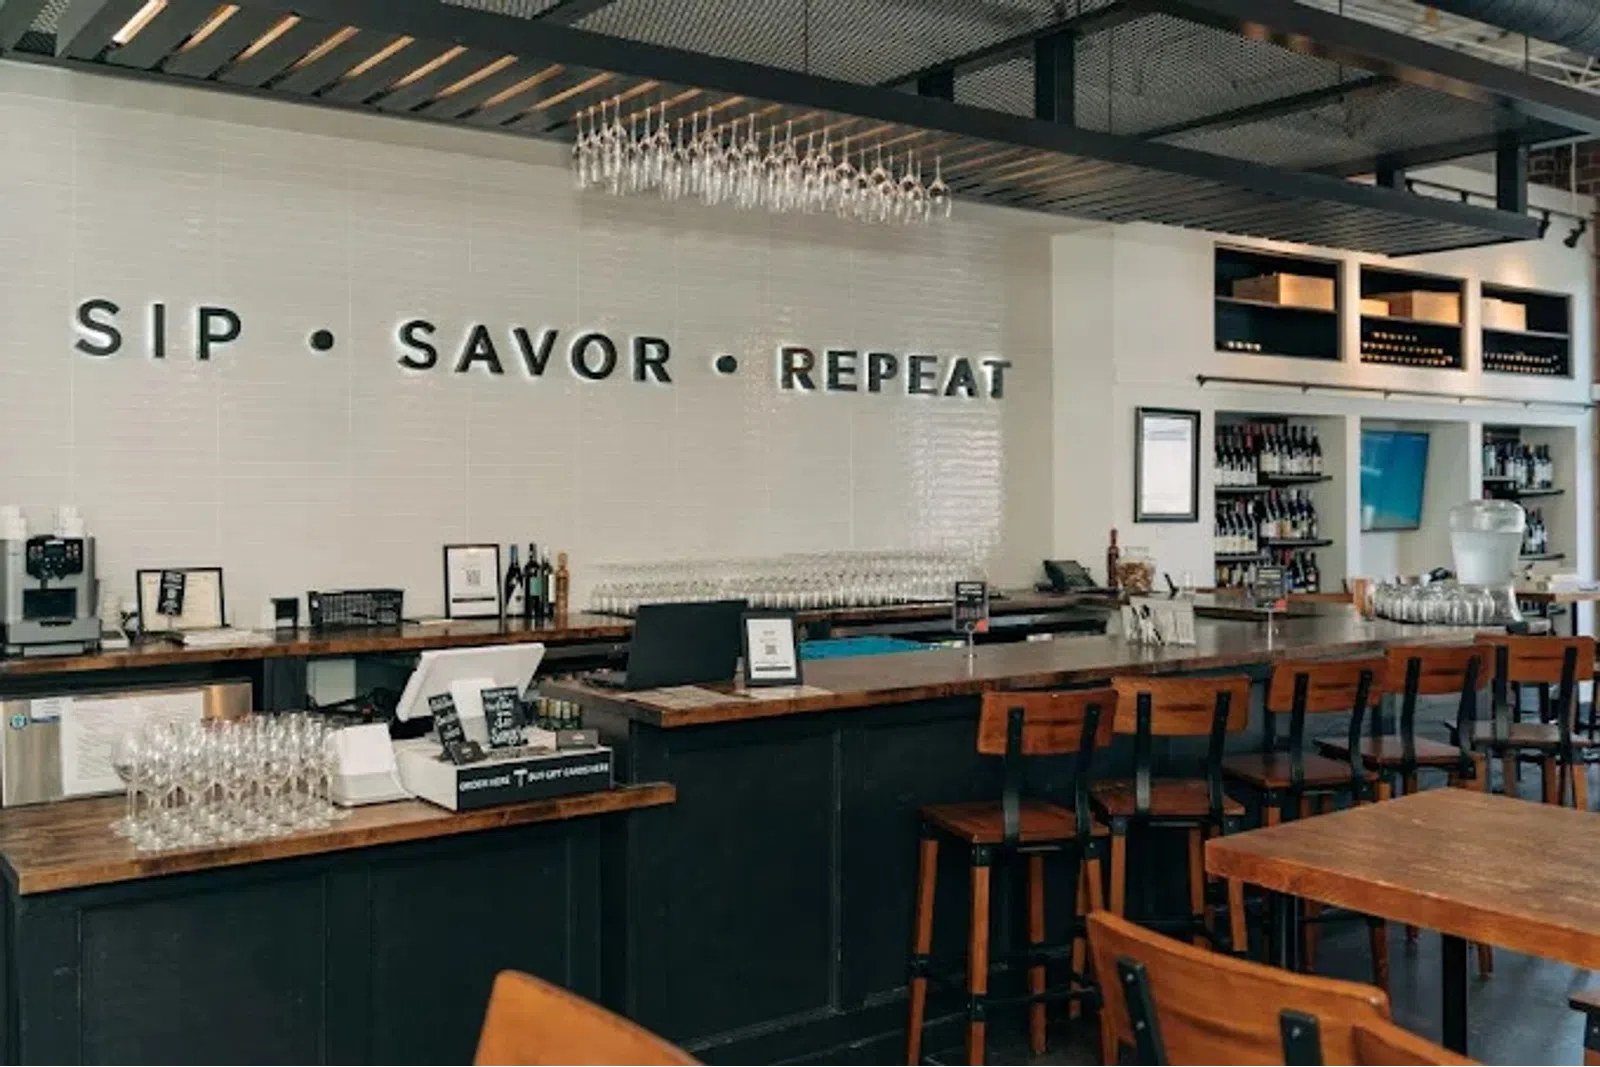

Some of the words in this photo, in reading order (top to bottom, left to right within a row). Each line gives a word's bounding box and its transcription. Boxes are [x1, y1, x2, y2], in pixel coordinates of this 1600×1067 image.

[75, 298, 243, 360] SIP
[397, 319, 673, 383] SAVOR
[780, 347, 1012, 399] REPEAT
